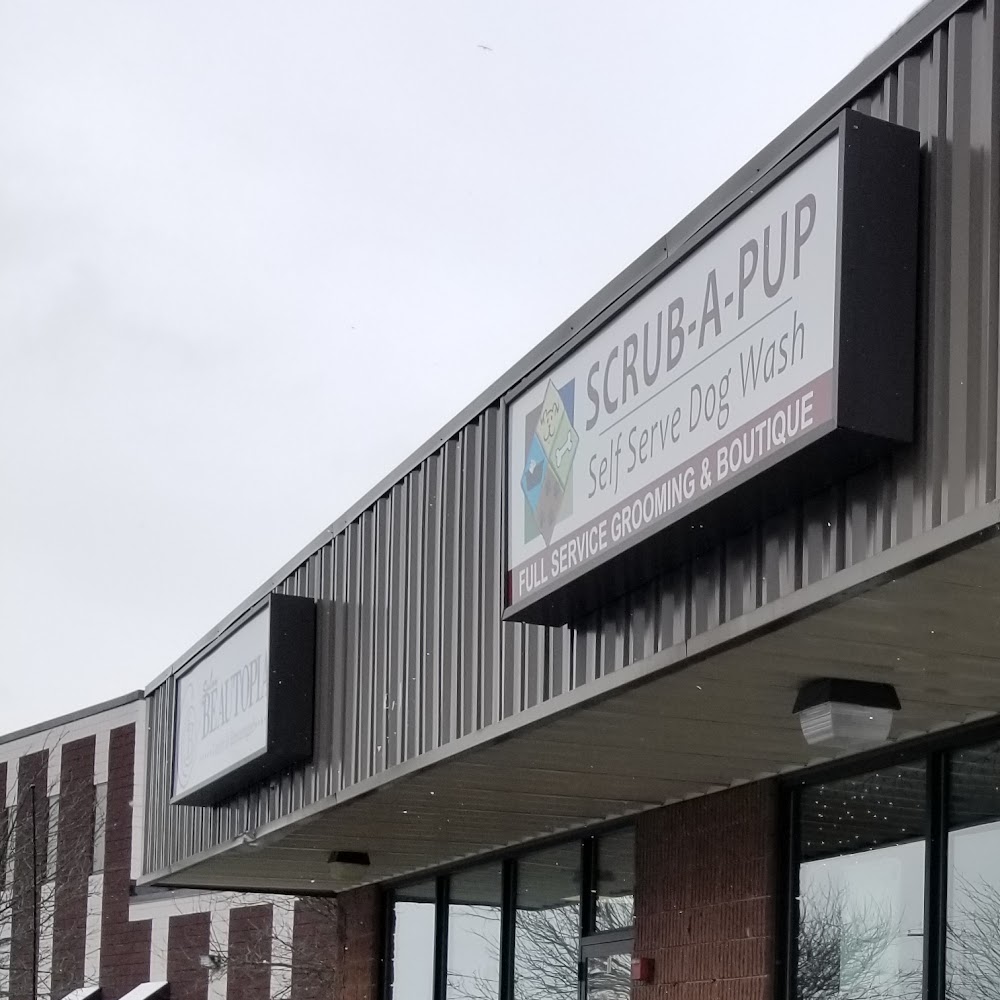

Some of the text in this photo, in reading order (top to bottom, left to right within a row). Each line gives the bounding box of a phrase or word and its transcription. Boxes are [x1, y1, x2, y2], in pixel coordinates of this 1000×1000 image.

[586, 193, 817, 431] SCRUB-A-PUP
[588, 310, 805, 498] Self Serve Dog Wash
[519, 391, 814, 597] FULL SERVICE GROOMING & BOUTIQUE
